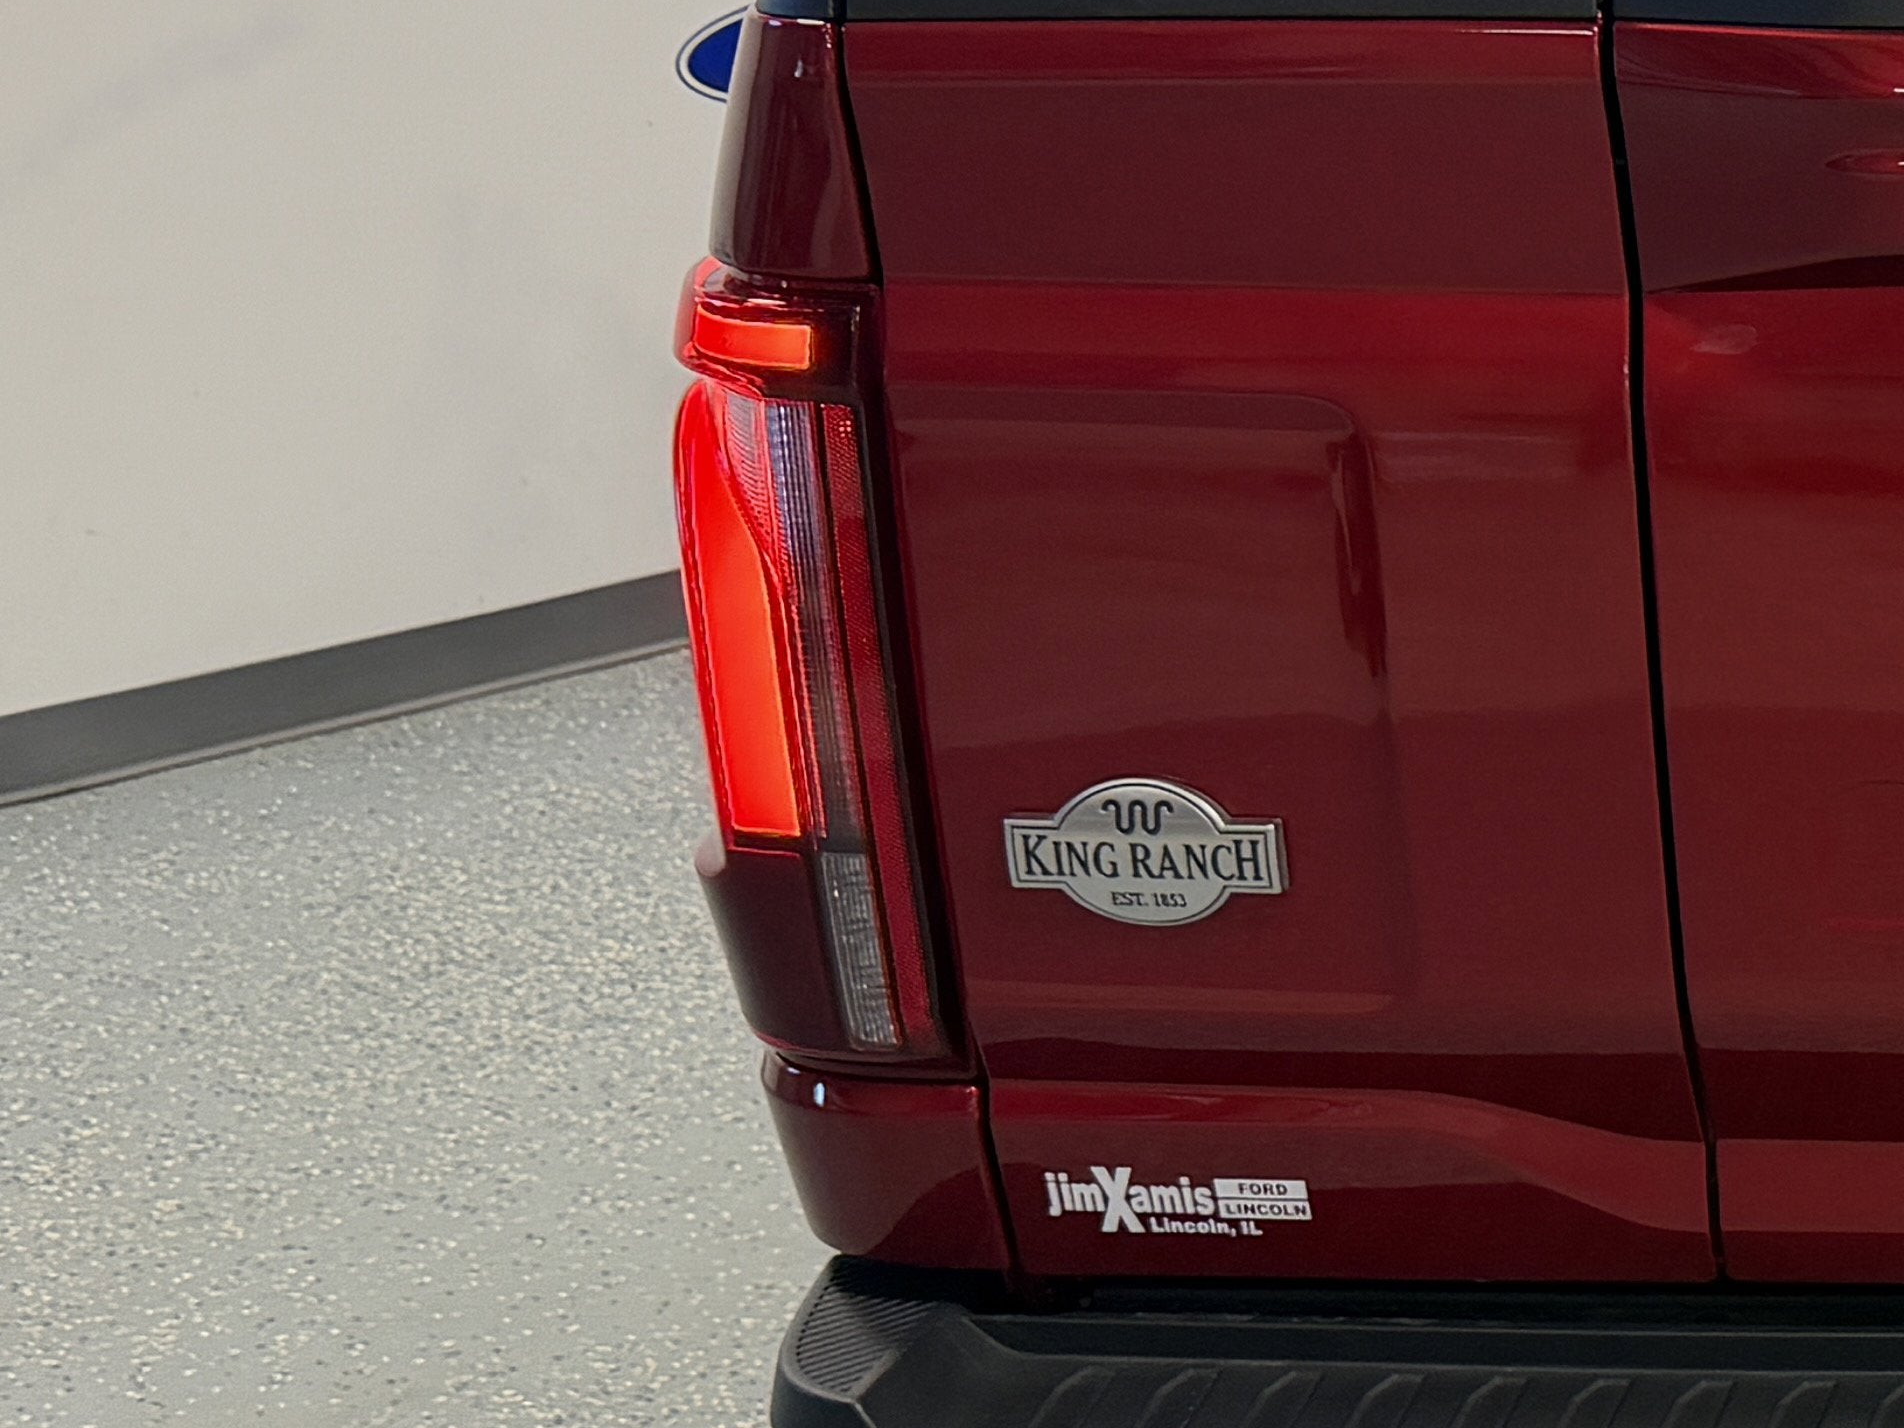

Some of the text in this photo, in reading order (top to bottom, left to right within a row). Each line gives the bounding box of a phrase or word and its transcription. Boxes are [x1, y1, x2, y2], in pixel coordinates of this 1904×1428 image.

[1020, 833, 1264, 881] KING RANCH
[1110, 890, 1188, 908] EST. 1853
[1237, 1182, 1288, 1196] FORD
[1224, 1203, 1308, 1217] LINCOLN
[1150, 1217, 1264, 1237] Lincoln, IL
